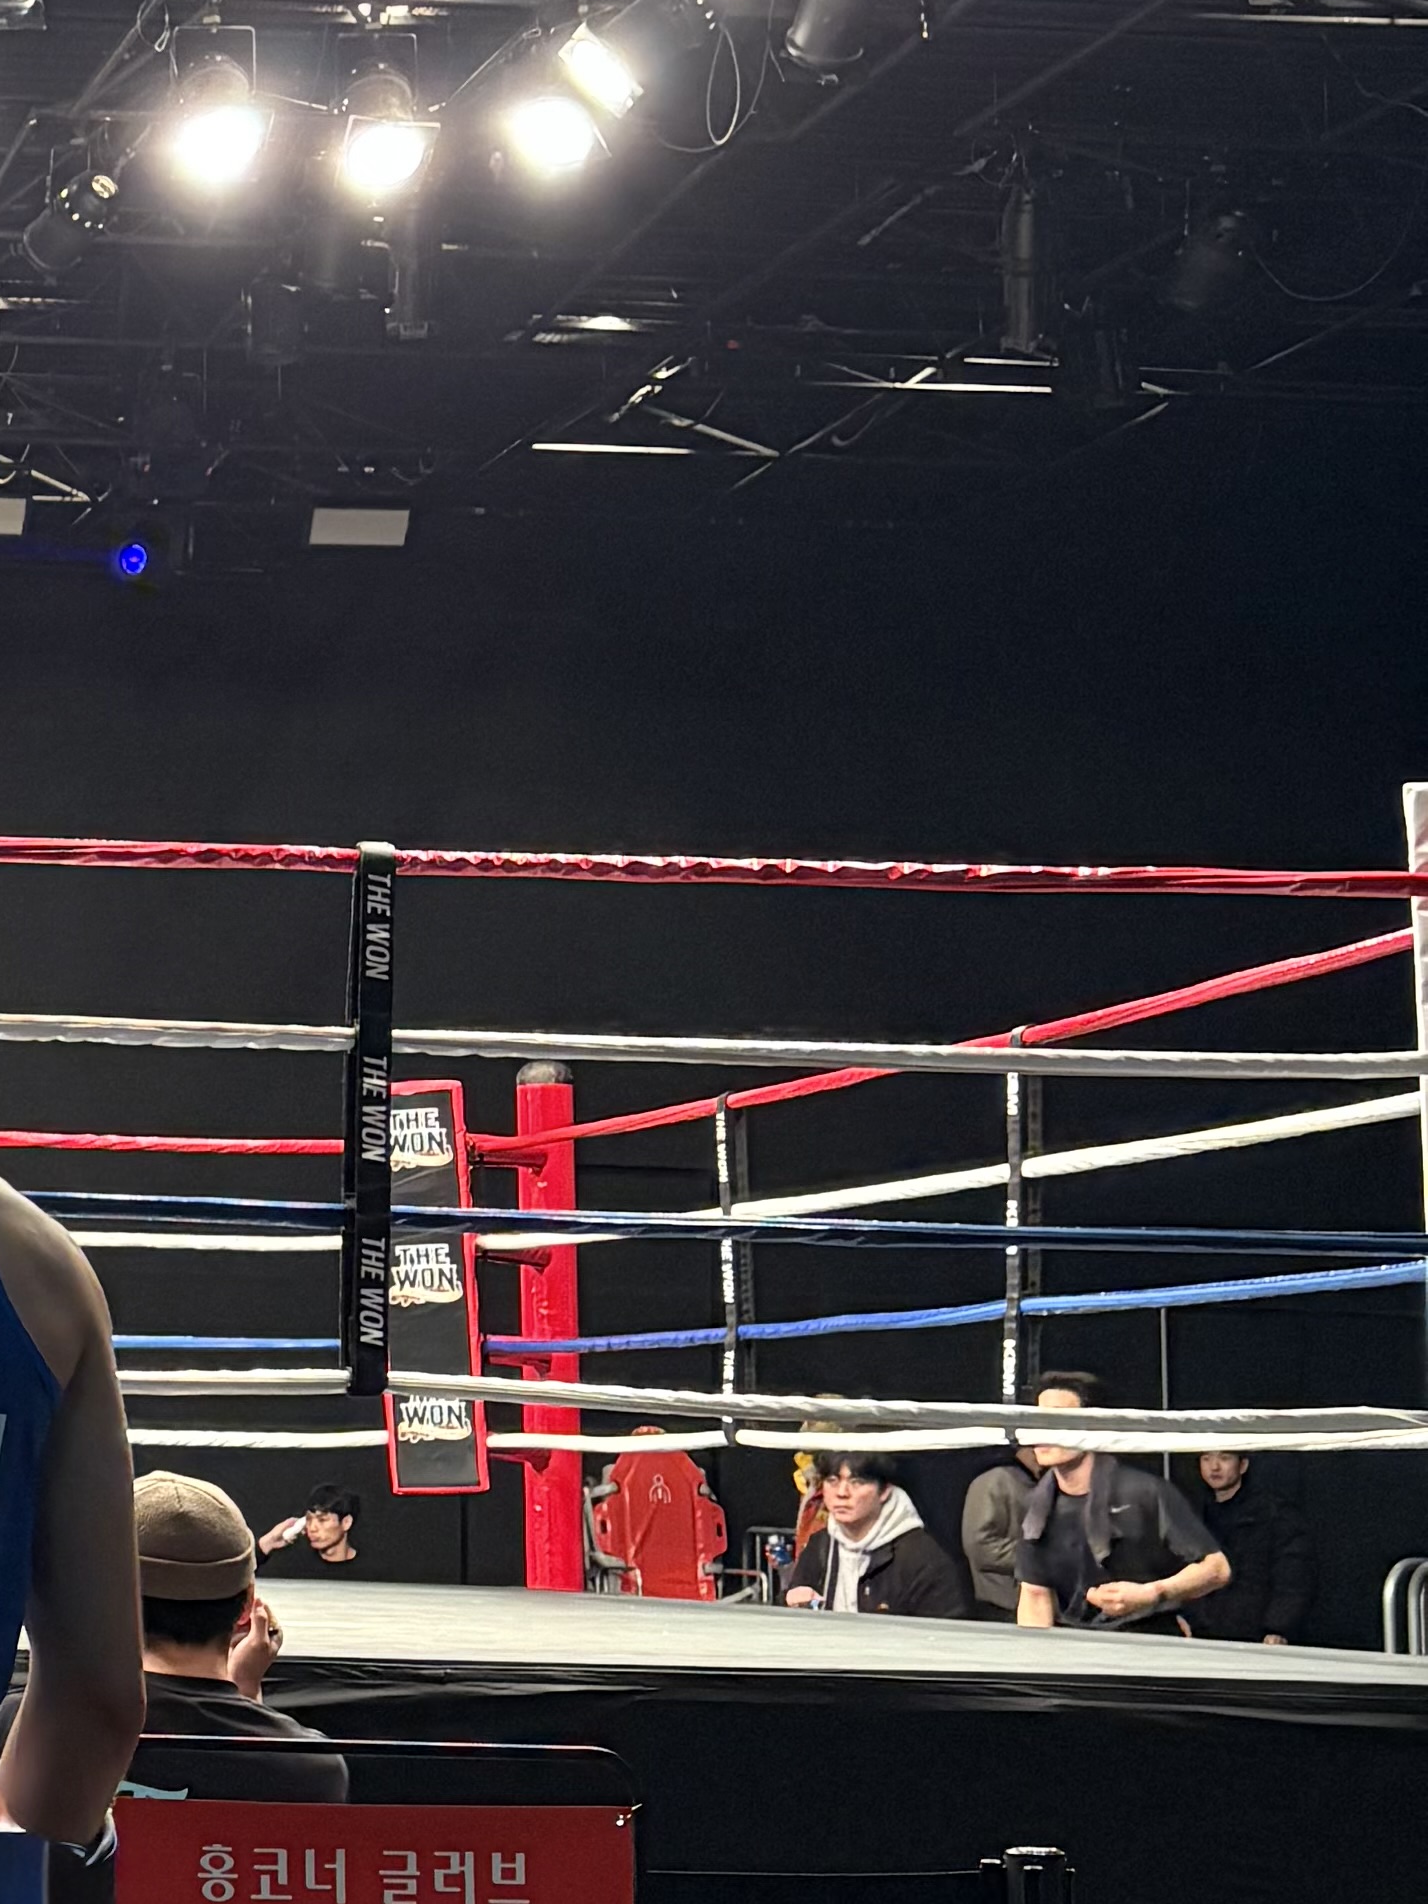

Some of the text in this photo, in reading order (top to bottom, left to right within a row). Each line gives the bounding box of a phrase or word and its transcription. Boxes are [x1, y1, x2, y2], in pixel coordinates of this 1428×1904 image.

[365, 874, 392, 980] THE WON
[361, 1056, 388, 1164] THE WON
[394, 1266, 456, 1292] WON
[398, 1247, 449, 1267] THE
[359, 1237, 386, 1346] THE WON
[405, 1404, 466, 1428] WON
[197, 1843, 346, 1904] 홍코너
